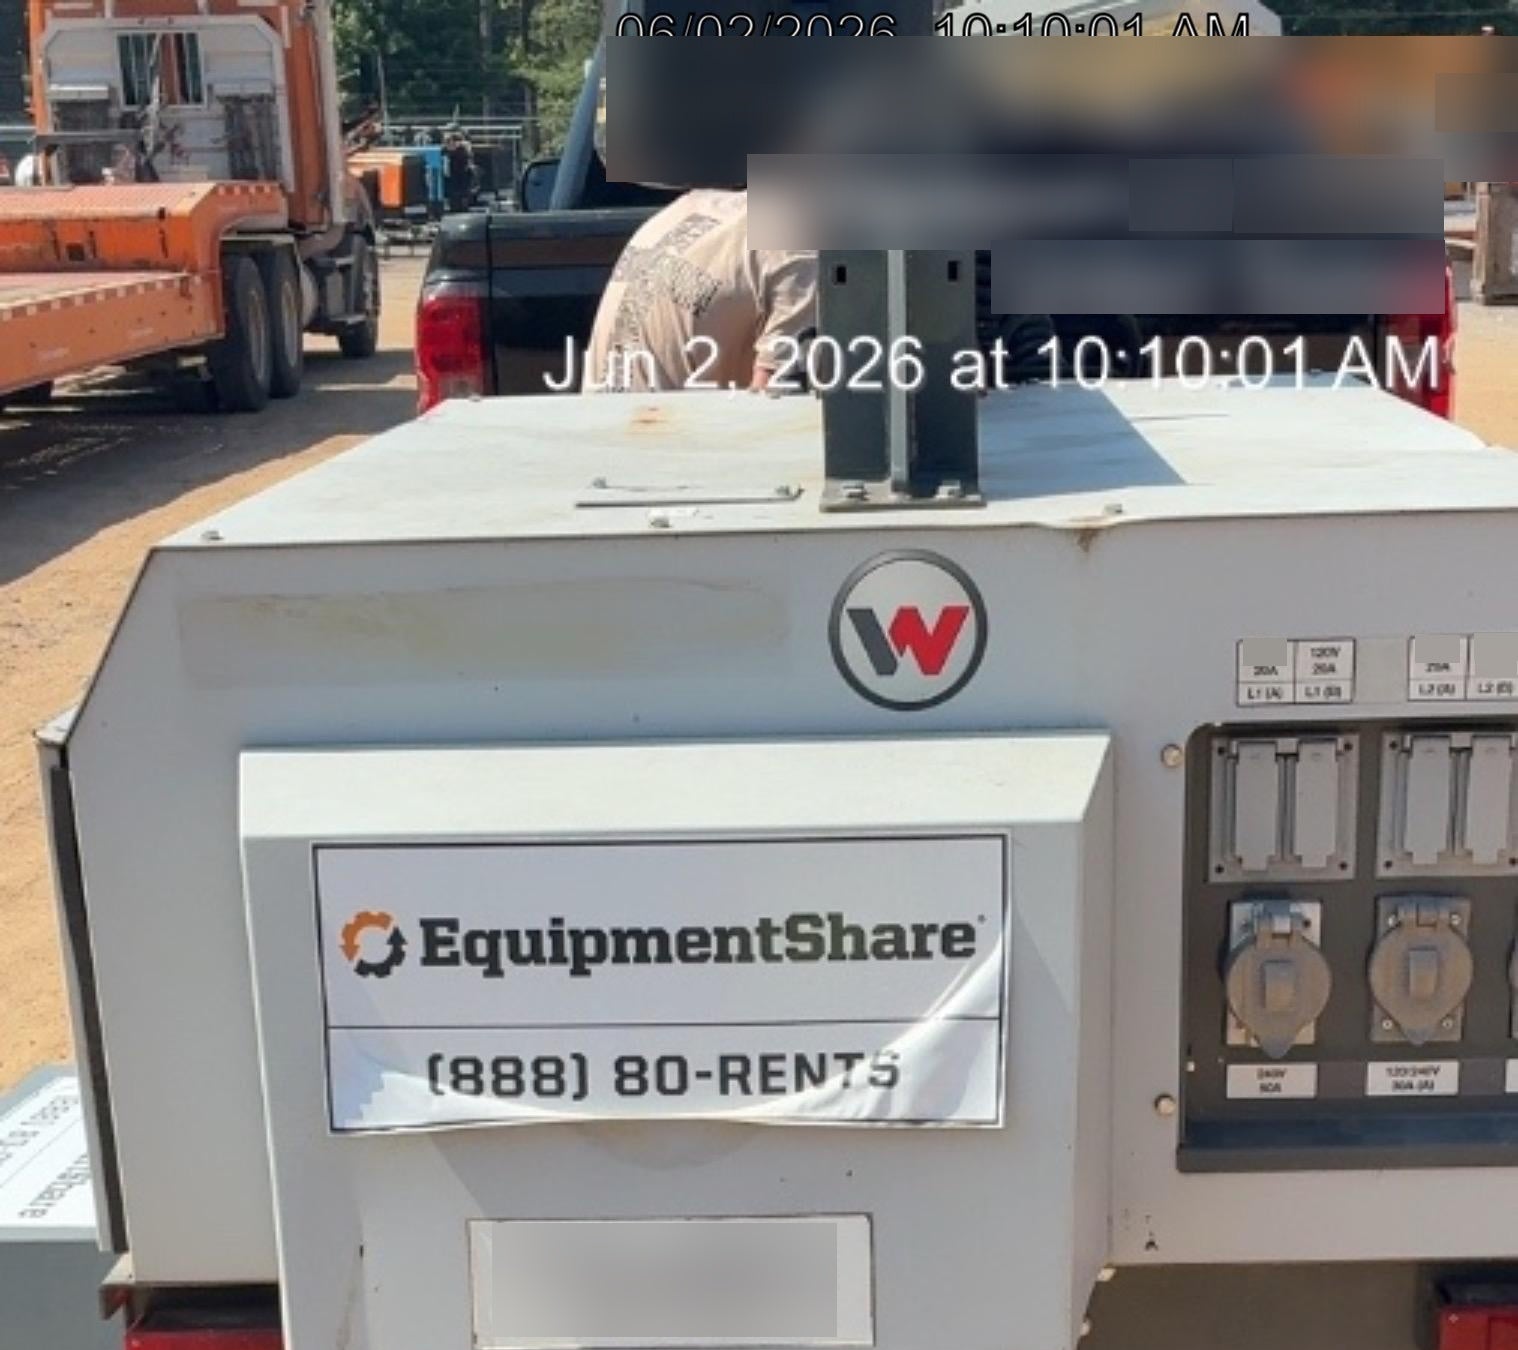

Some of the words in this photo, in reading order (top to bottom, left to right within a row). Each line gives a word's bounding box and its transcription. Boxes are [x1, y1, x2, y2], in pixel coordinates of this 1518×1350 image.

[419, 912, 976, 979] EquipmentShare
[427, 1052, 590, 1101] (888)
[613, 1047, 901, 1098] 80-RENTS
